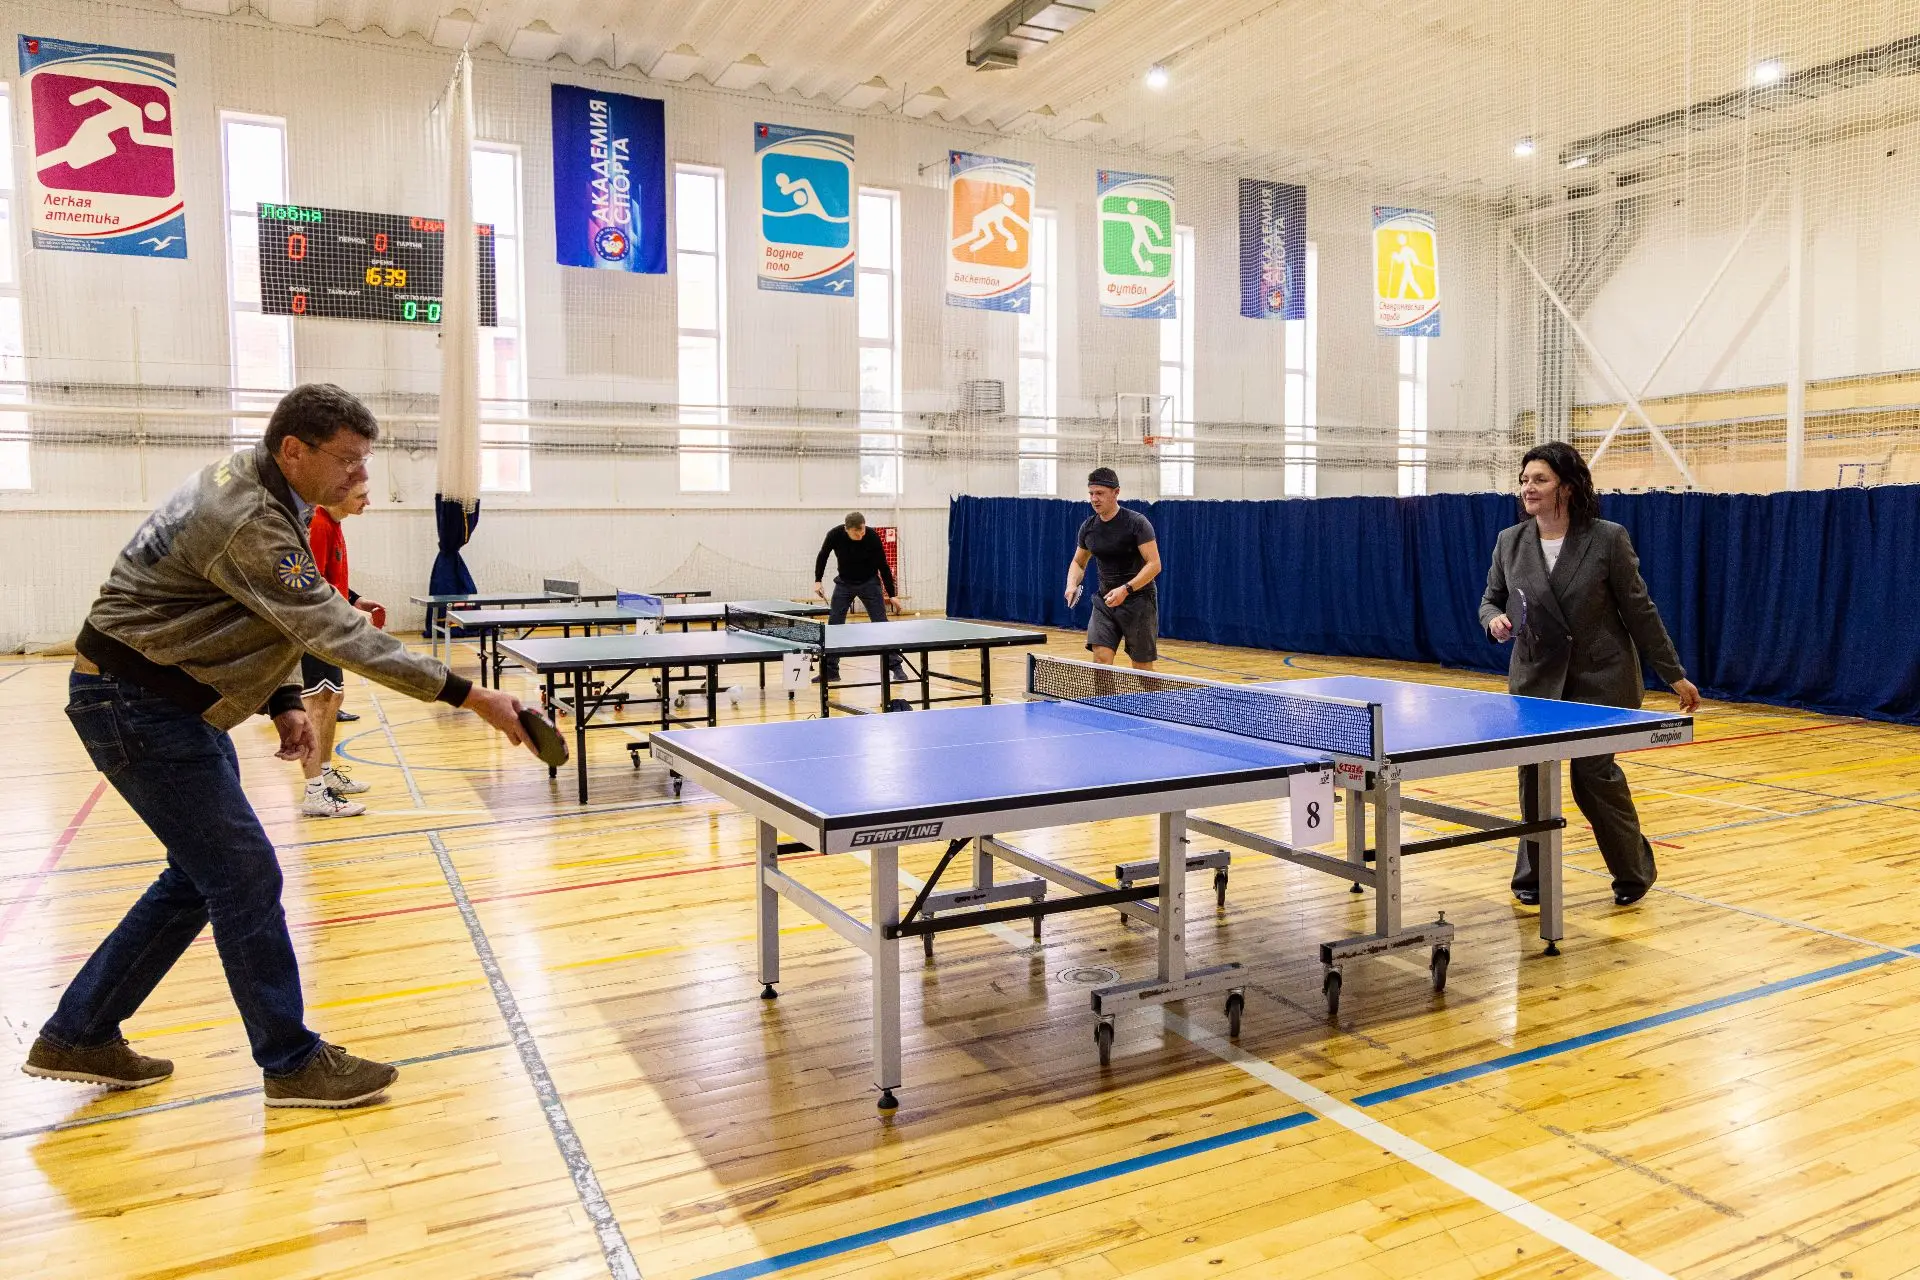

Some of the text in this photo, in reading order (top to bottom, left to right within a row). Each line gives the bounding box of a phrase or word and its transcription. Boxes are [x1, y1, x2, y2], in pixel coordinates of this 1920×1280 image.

[590, 99, 609, 223] АКАДЕМИЯ
[612, 137, 631, 225] СПОРТА
[44, 193, 92, 208] Легкая
[45, 210, 120, 225] атлетика
[261, 203, 322, 223] Лобня
[288, 233, 306, 260] 0
[338, 236, 366, 245] ПЕРИОД
[375, 233, 387, 252] 0
[396, 241, 422, 249] ПАРТИЯ
[766, 246, 804, 260] Водное
[766, 262, 790, 272] поло
[954, 272, 1000, 287] Баскетбол
[1107, 282, 1147, 296] Футбол
[292, 295, 306, 313] 0
[793, 668, 801, 681] 7
[1650, 730, 1682, 744] Champion
[1306, 801, 1320, 828] 8
[854, 823, 941, 846] START LINE
